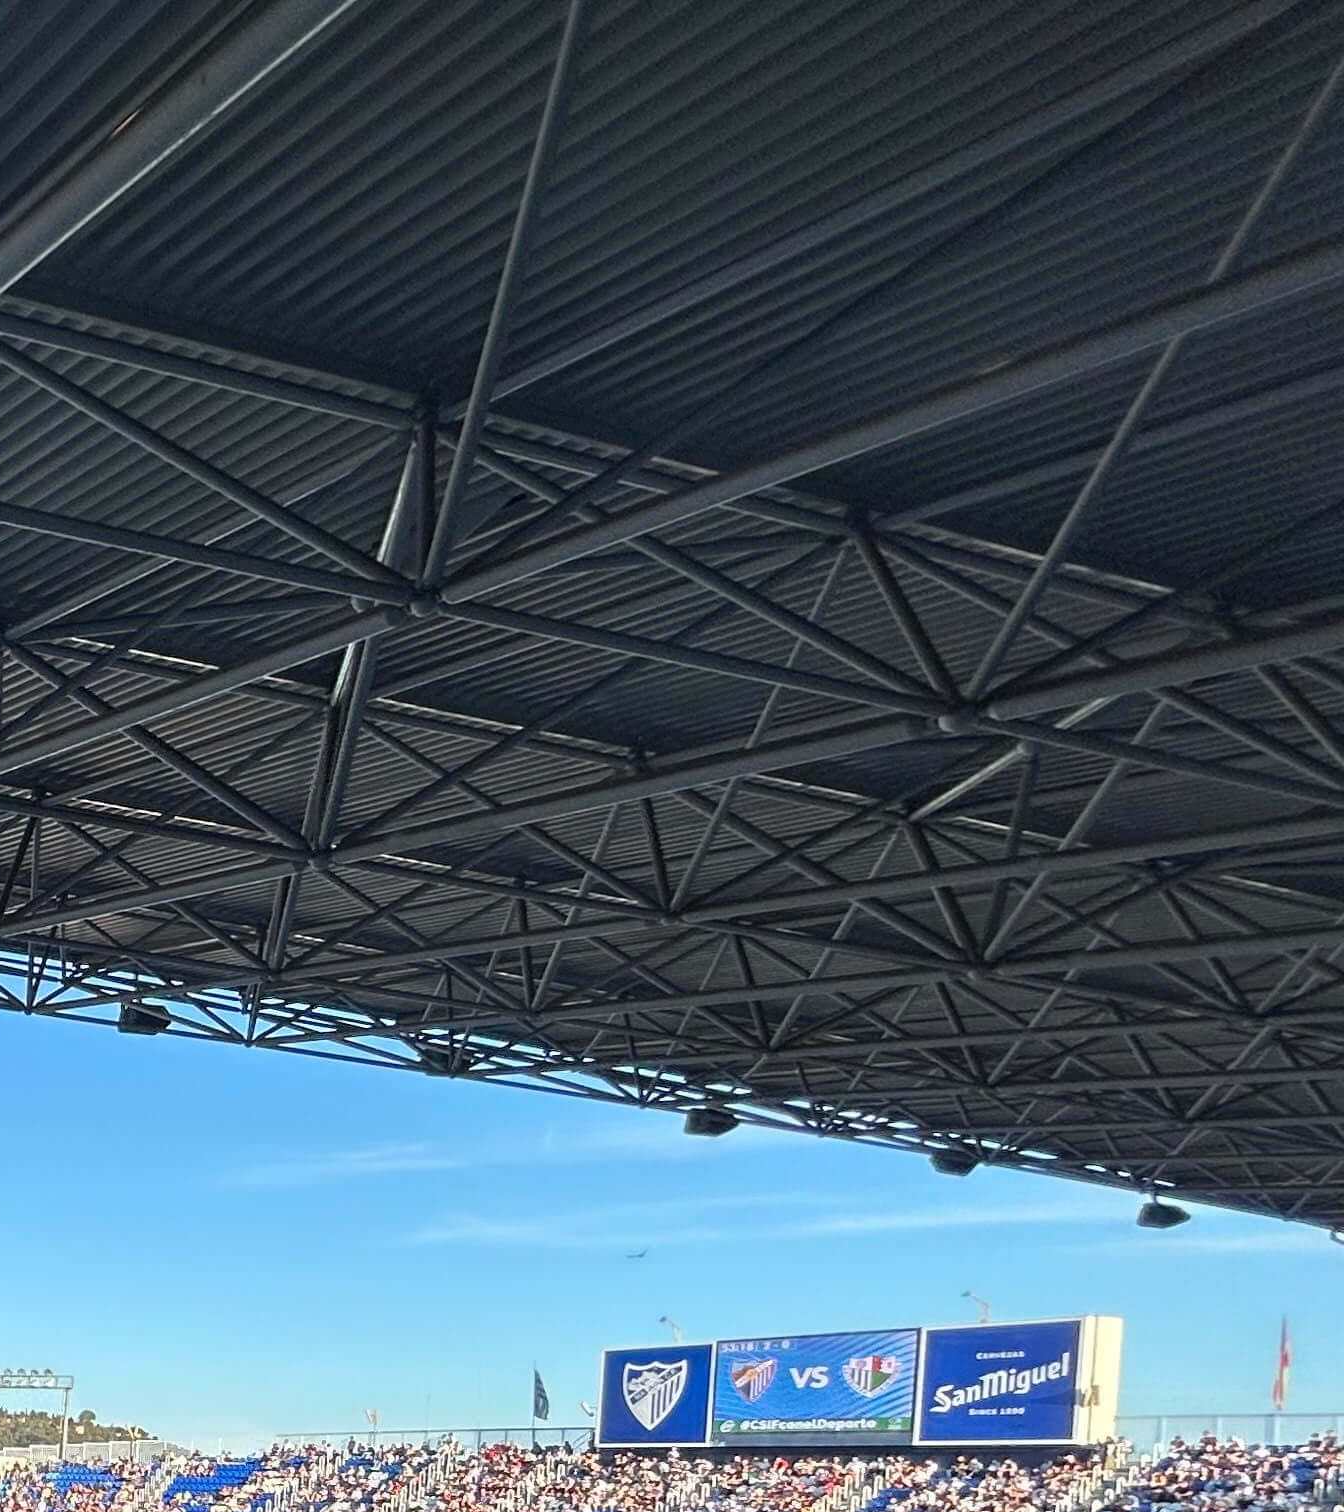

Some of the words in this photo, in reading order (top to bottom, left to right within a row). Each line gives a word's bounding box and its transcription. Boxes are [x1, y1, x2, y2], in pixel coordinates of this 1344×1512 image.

[976, 1350, 1025, 1360] CERVEZAS
[789, 1366, 830, 1389] VS
[968, 1408, 998, 1416] SINCE
